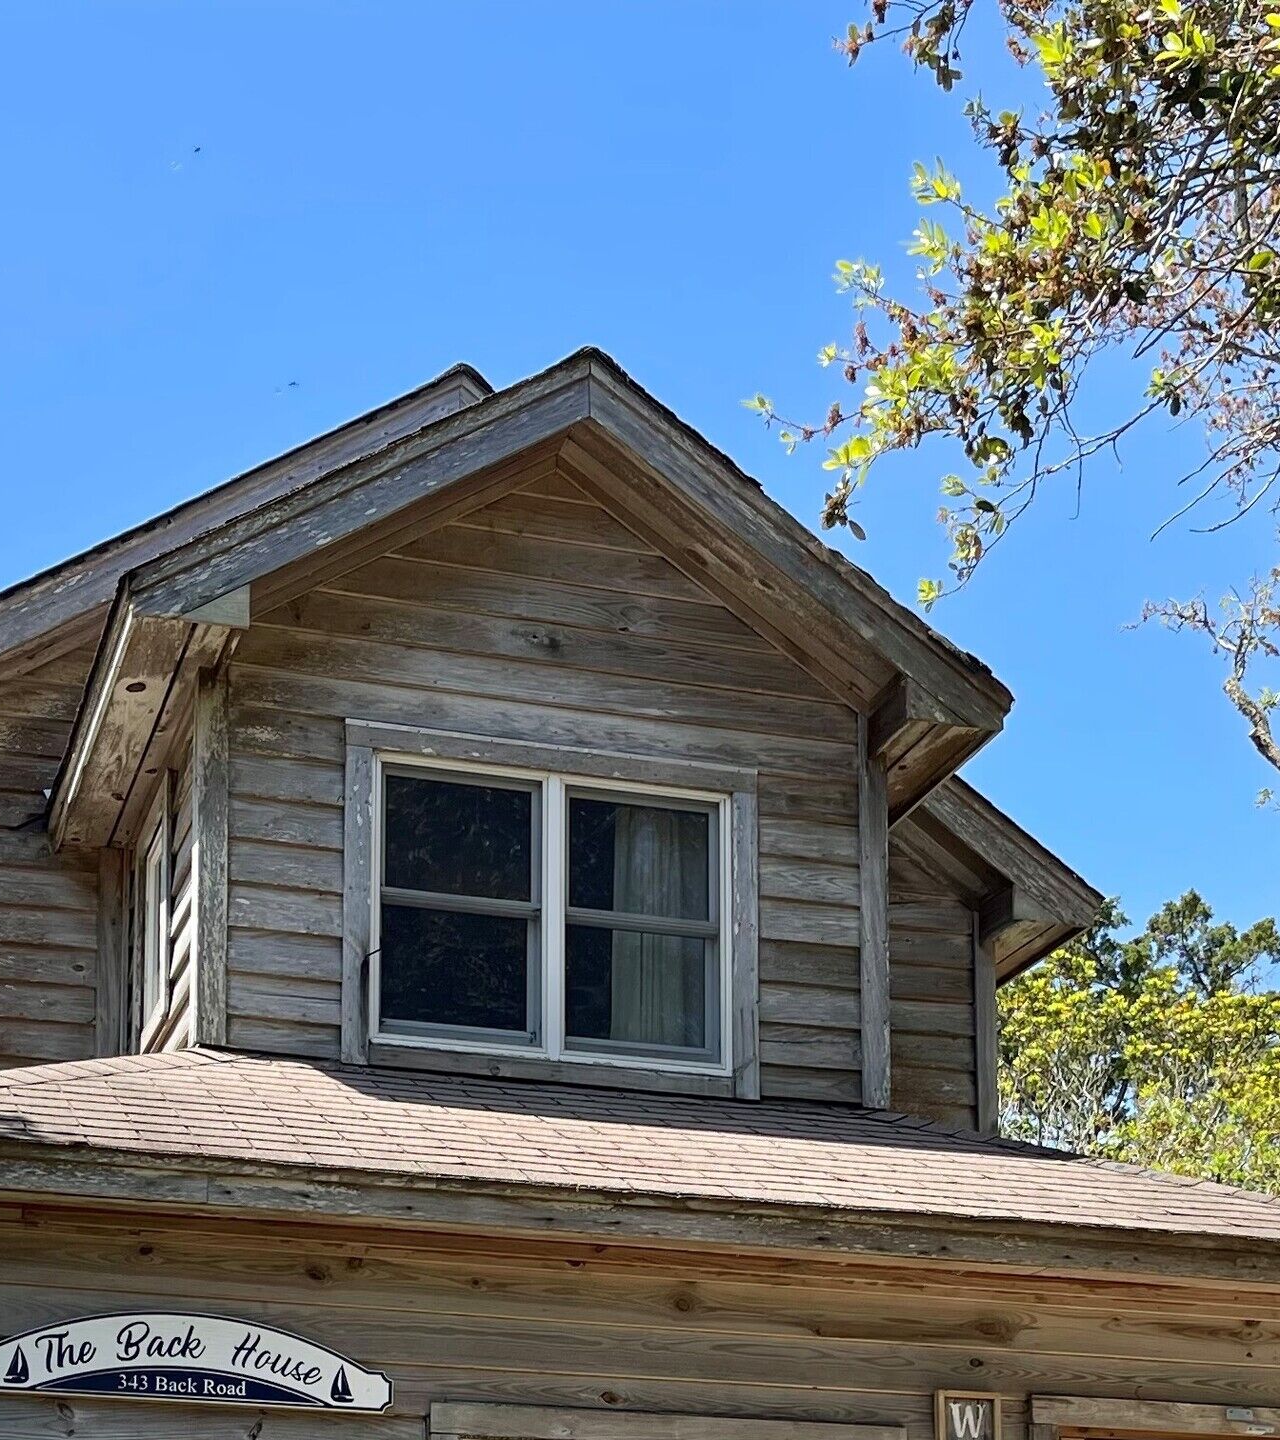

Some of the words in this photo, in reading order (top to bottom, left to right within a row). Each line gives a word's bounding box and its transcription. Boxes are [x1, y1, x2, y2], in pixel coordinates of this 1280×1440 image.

[35, 1331, 97, 1372] The
[116, 1321, 206, 1363] Back
[231, 1331, 323, 1385] House
[117, 1374, 149, 1391] 343
[155, 1376, 198, 1395] Back
[203, 1379, 247, 1397] Road
